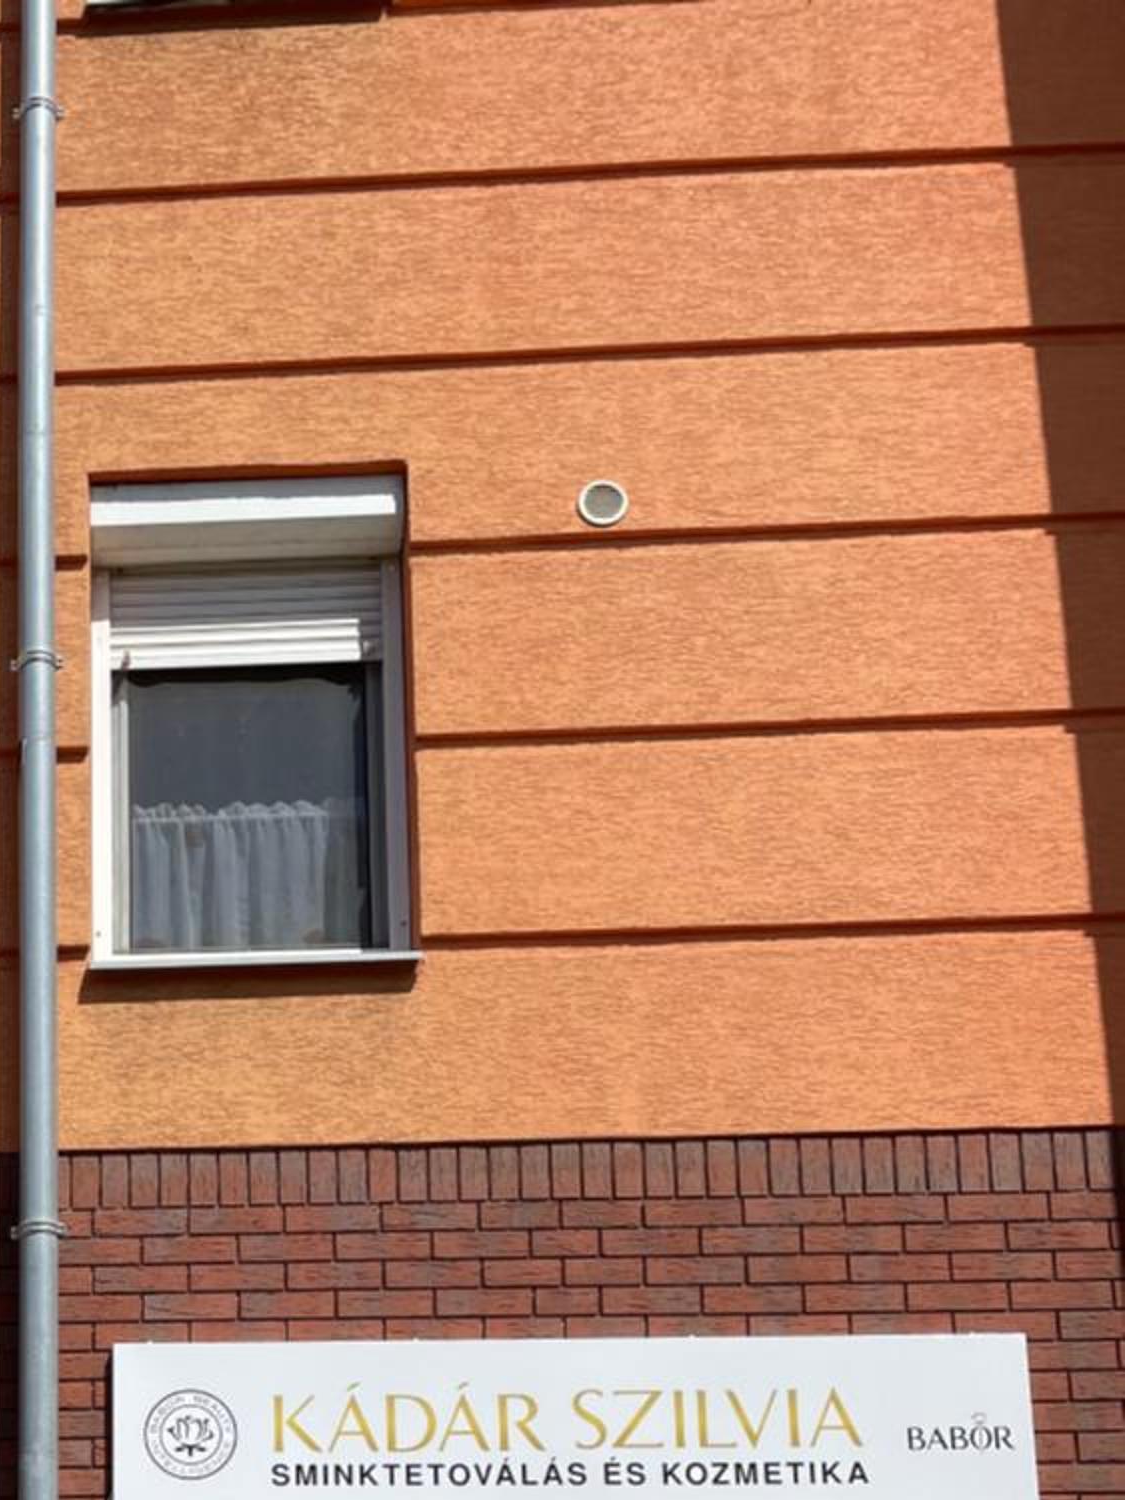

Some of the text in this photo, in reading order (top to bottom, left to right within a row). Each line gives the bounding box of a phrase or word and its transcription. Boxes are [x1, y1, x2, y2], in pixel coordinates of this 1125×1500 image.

[272, 1382, 864, 1453] KÁDÁR SZILVIA
[271, 1456, 870, 1487] SMINKTETOVÁLÁS ÉS KOZMETIKA
